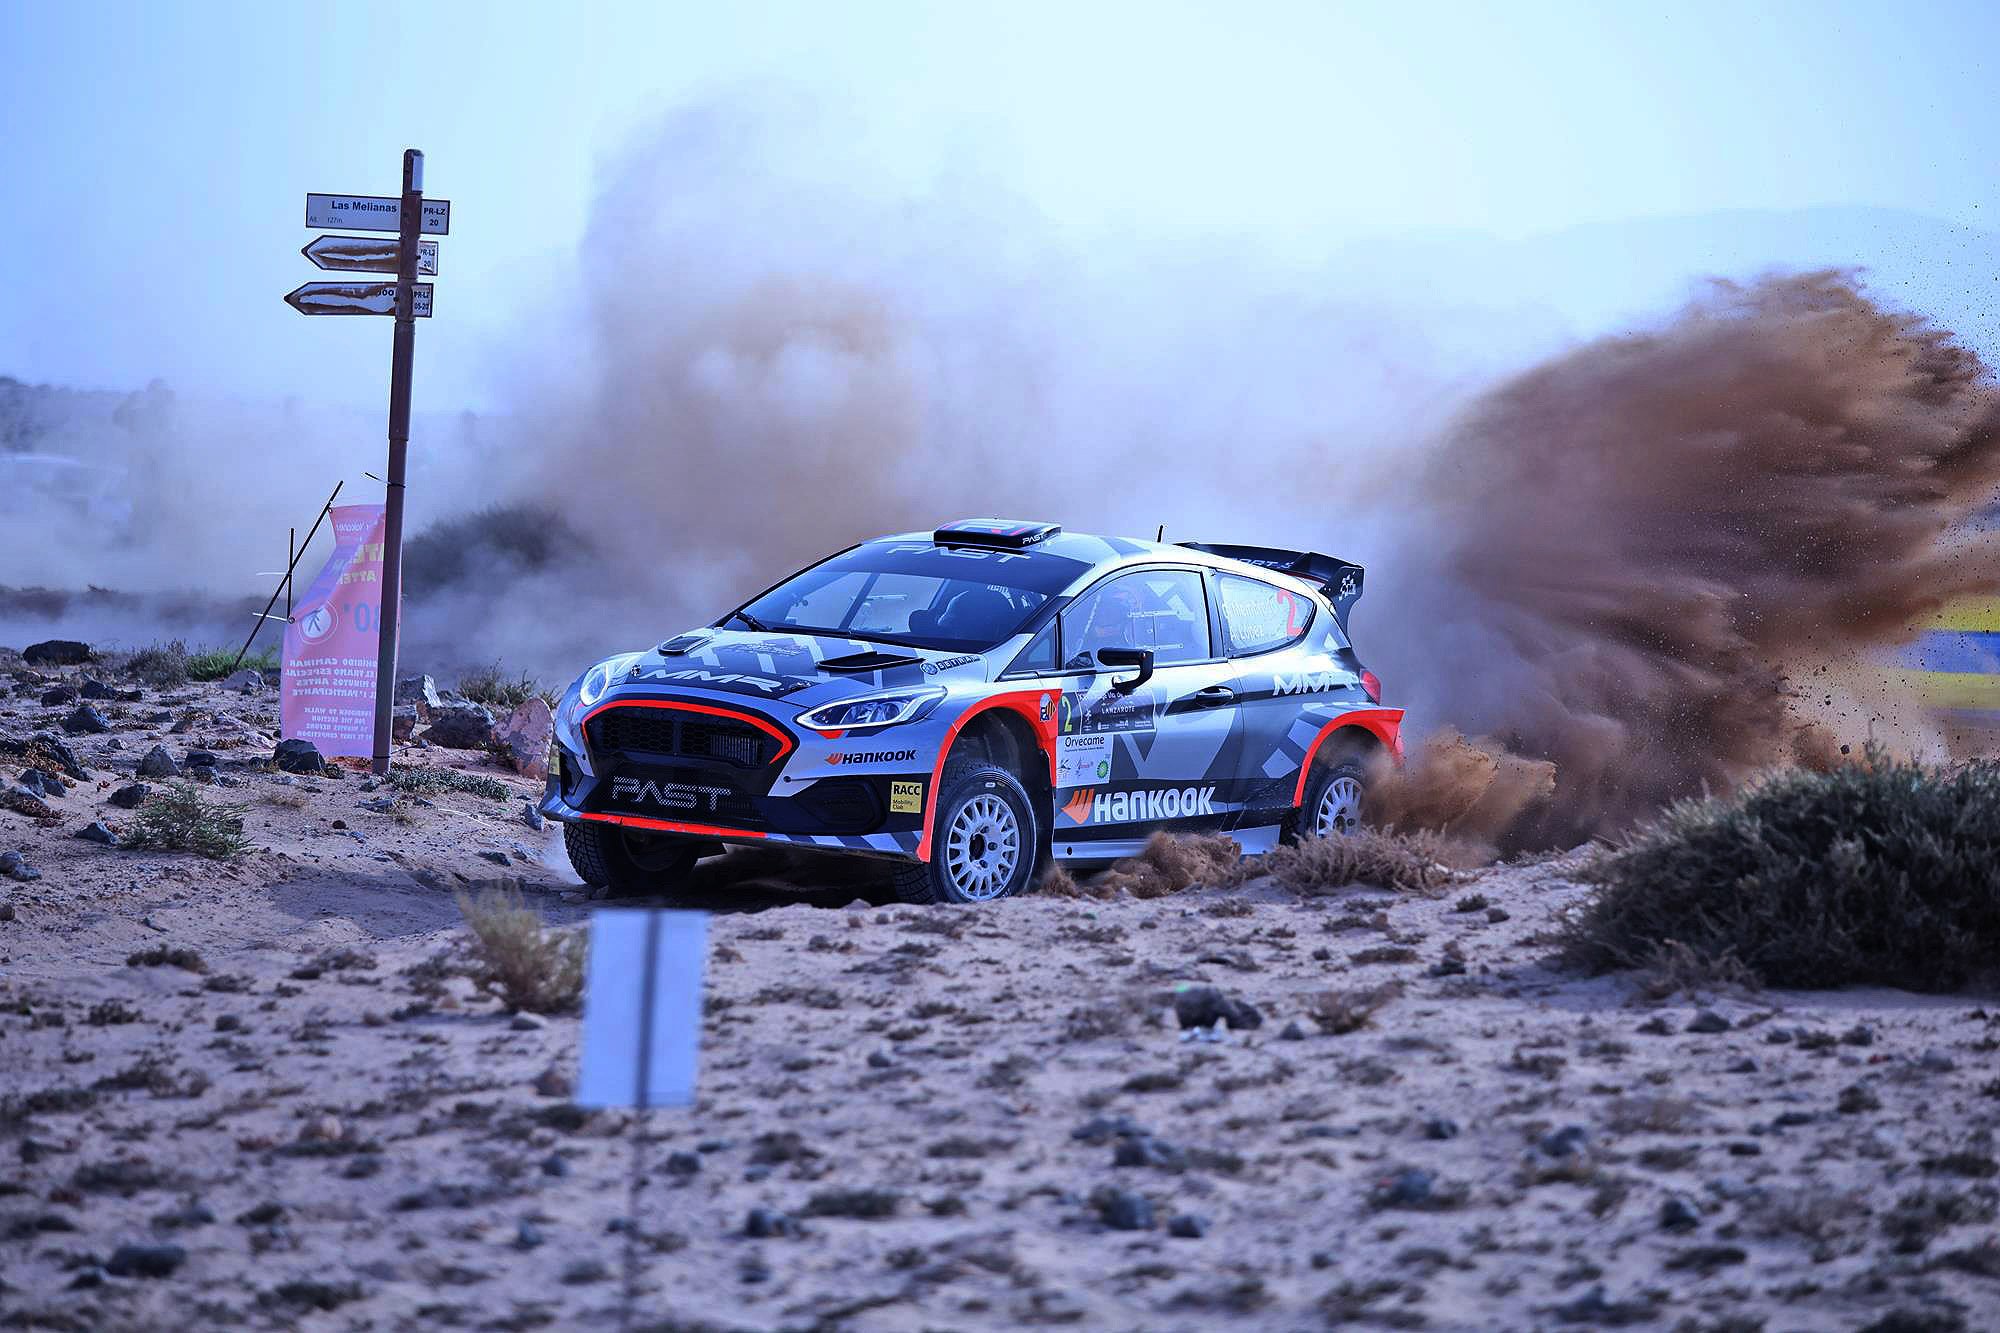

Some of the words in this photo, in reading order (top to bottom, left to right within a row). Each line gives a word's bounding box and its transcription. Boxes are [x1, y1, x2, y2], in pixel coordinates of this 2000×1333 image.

[331, 200, 350, 210] Las
[352, 201, 398, 213] Melianas
[423, 207, 446, 216] PR-LZ
[429, 218, 439, 227] 20
[886, 545, 1031, 563] PAST
[1276, 588, 1304, 637] 2
[639, 669, 782, 693] MMR
[1061, 695, 1073, 732] 2
[1101, 705, 1135, 714] LANZAROTE
[1064, 736, 1105, 747] Orvecame
[612, 776, 732, 811] PAST
[893, 784, 921, 796] RACC
